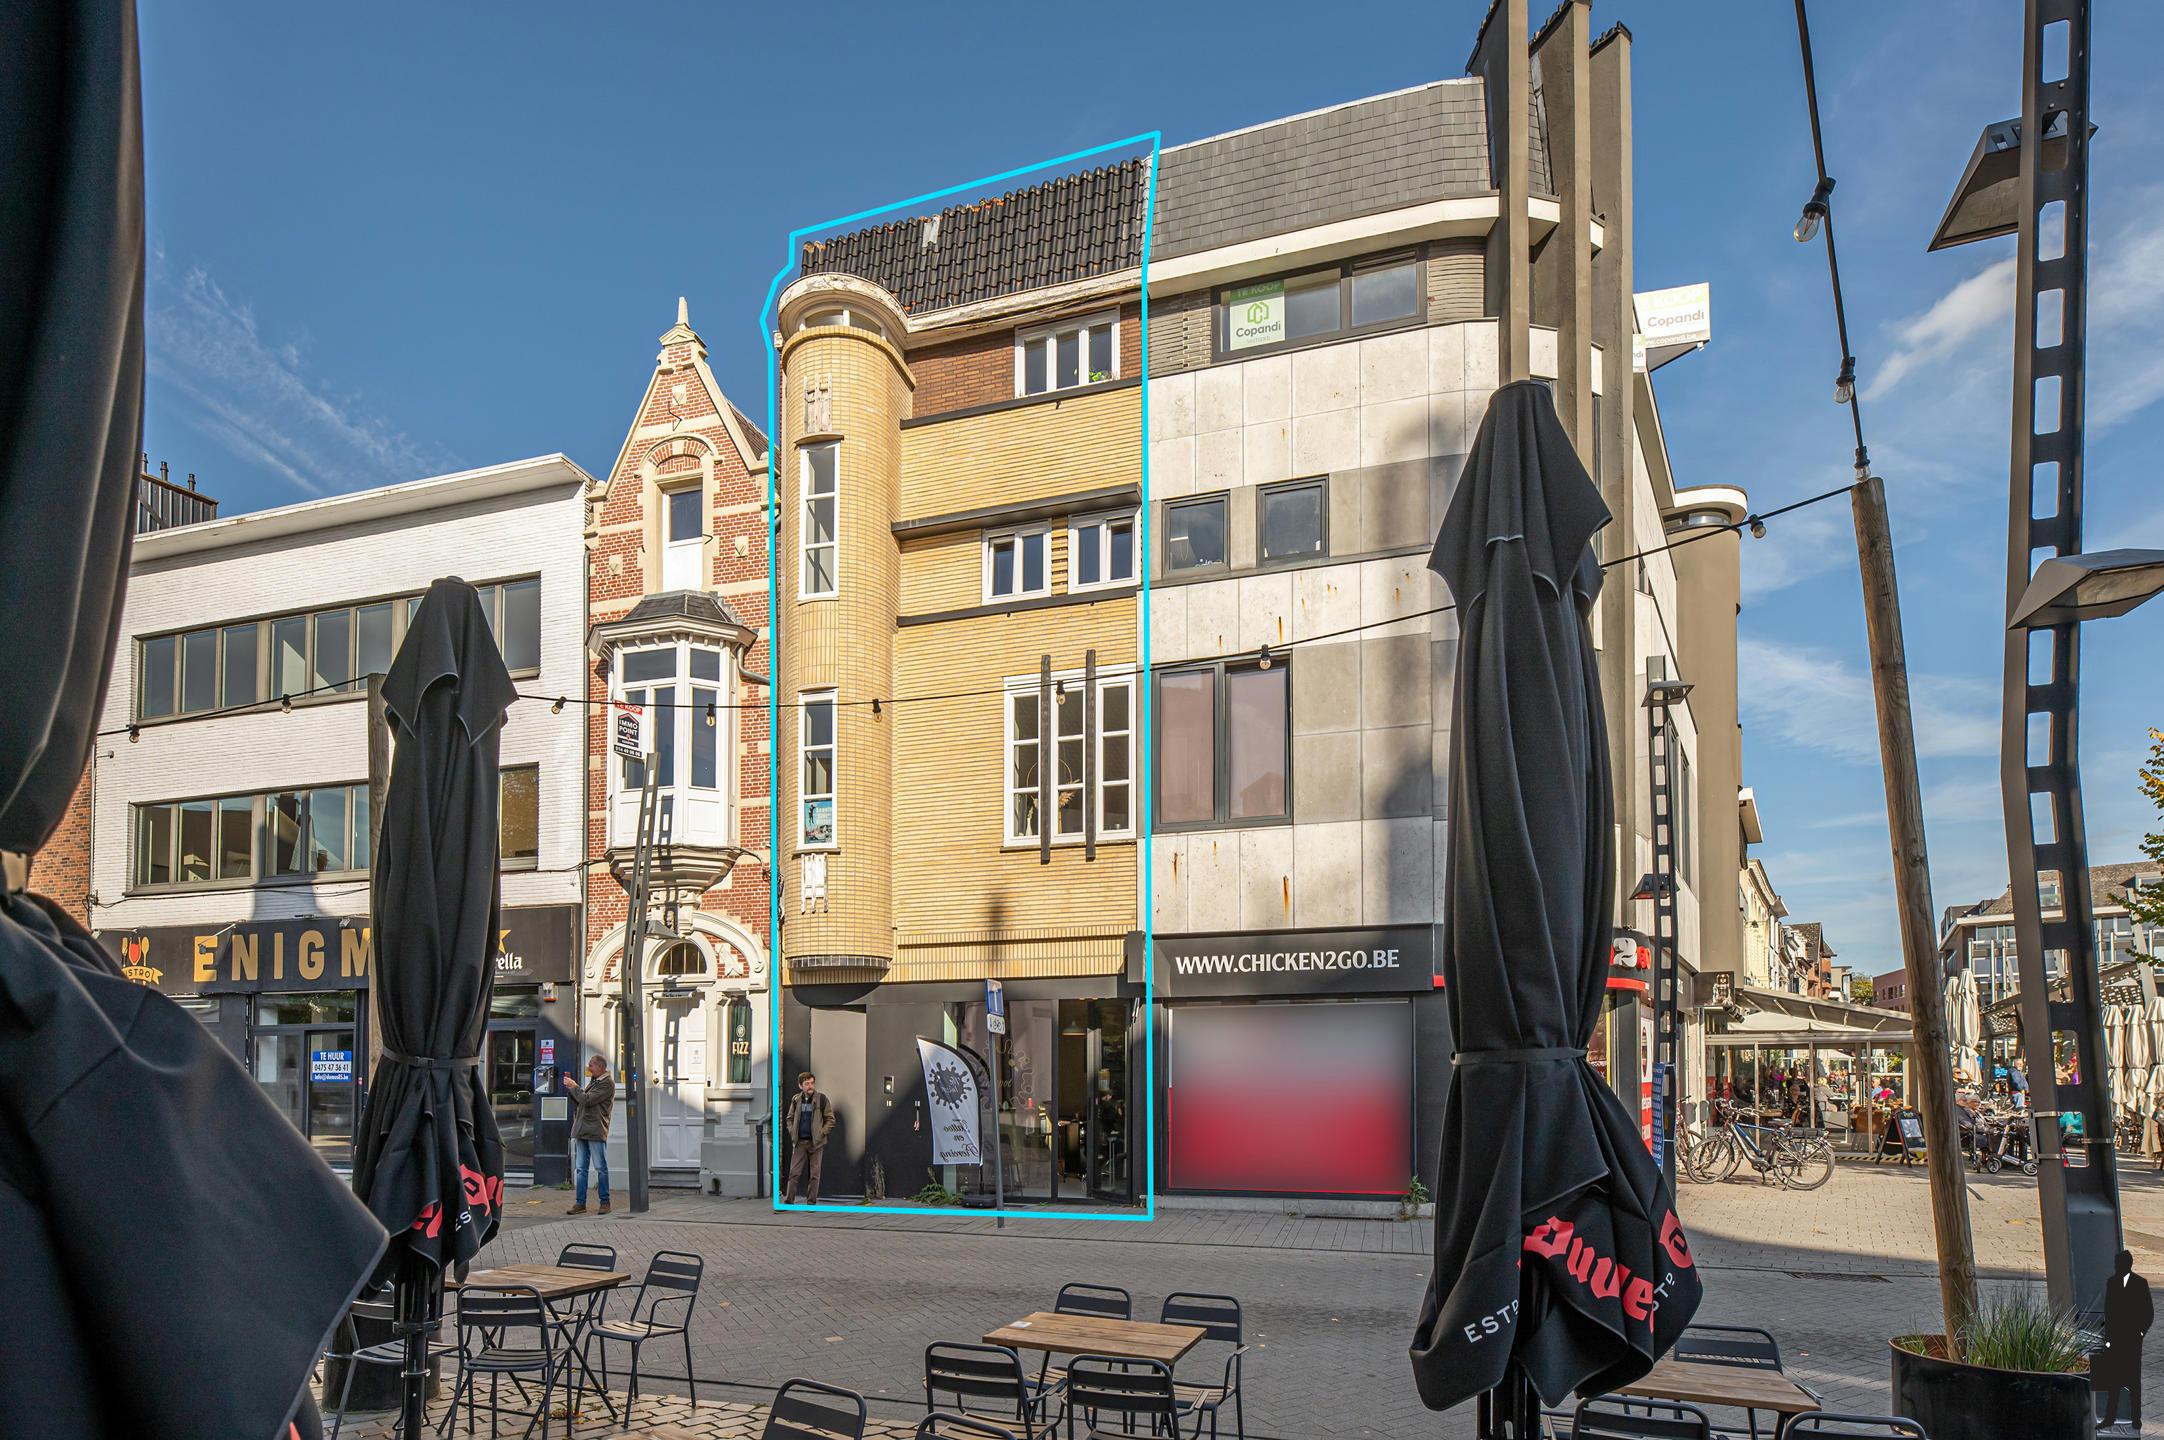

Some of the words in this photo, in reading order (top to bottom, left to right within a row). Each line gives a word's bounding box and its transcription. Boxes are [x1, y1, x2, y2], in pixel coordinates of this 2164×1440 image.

[1251, 281, 1280, 295] KOOP
[1647, 309, 1705, 327] Copandi
[1236, 320, 1281, 337] Copandi
[619, 719, 638, 730] IMMO
[619, 726, 638, 736] POINT
[1175, 949, 1400, 975] WWW.CHICKEN2GO.BE
[732, 1042, 749, 1055] FIZZ
[320, 1052, 327, 1060] TE
[327, 1051, 345, 1060] HUUR
